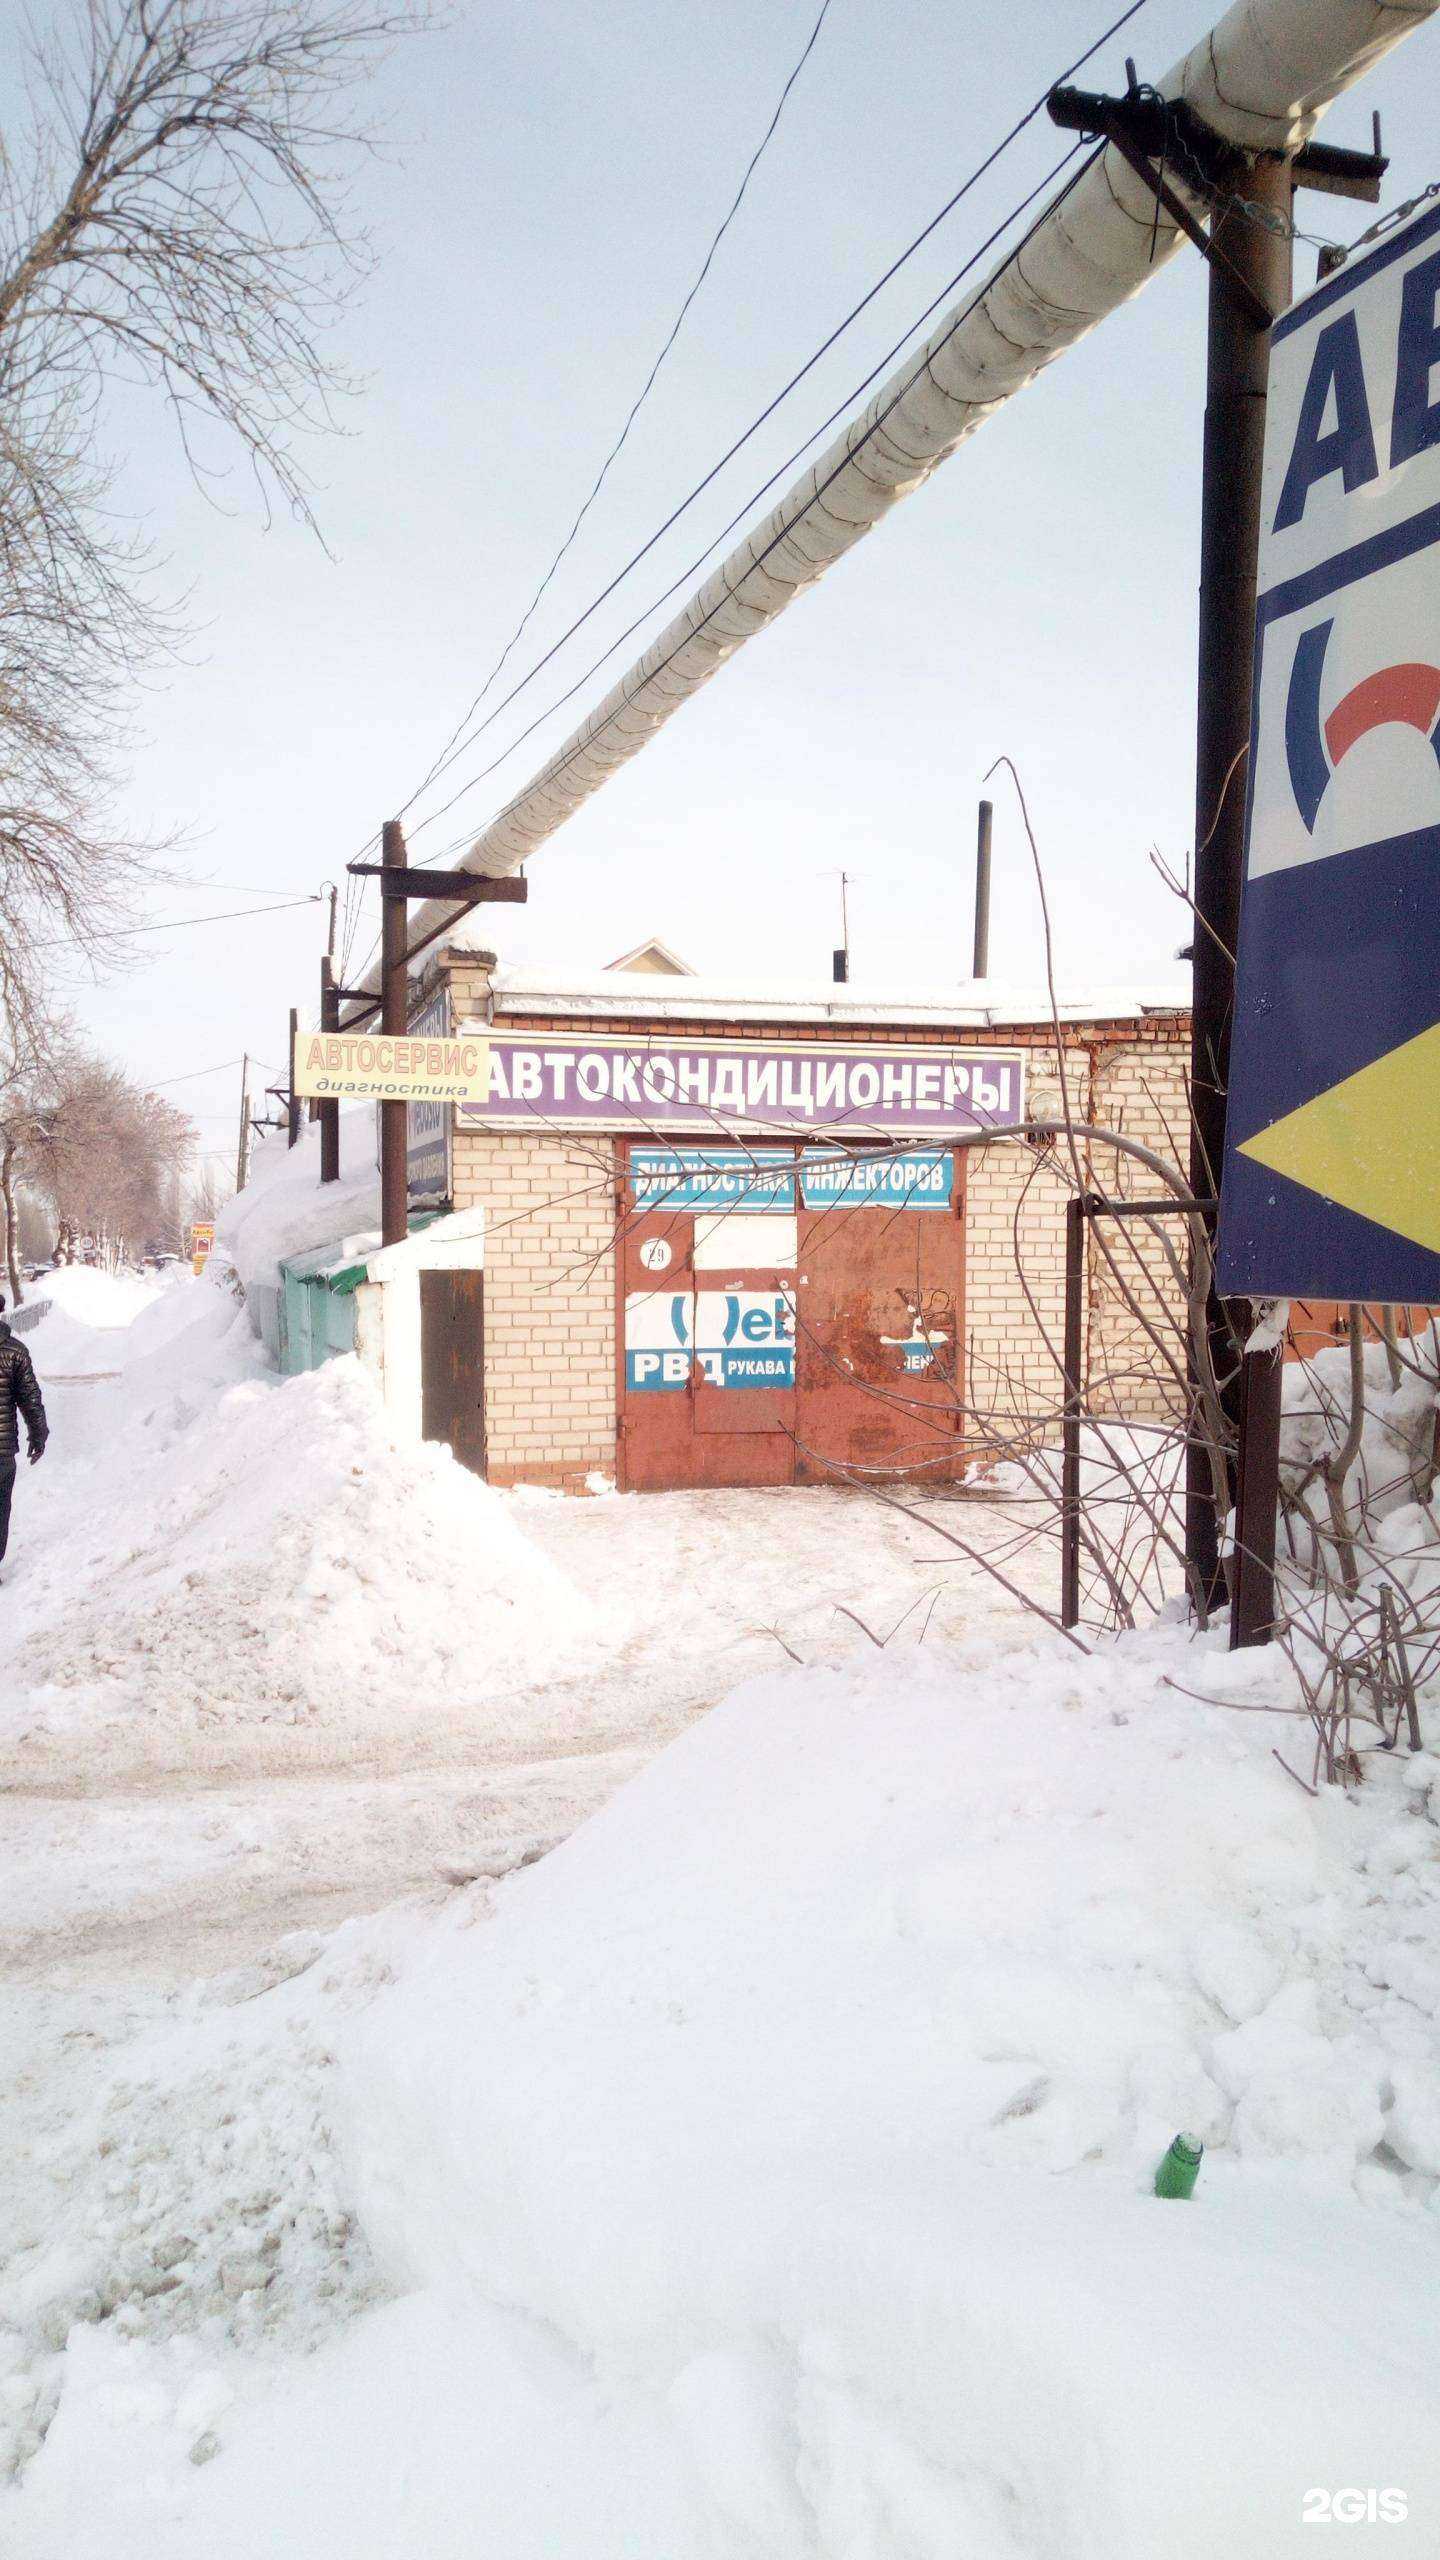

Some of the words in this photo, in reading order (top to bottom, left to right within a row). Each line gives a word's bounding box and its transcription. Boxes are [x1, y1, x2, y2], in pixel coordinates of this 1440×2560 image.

[306, 1038, 478, 1078] АВТОСЕРВИС
[316, 1077, 468, 1096] диагностика
[487, 1050, 1011, 1117] АВТОКОНДИЦИОНЕРЫ
[805, 1160, 944, 1191] ИНЖЕКТОРОВ
[634, 1353, 725, 1386] РВД
[727, 1360, 786, 1376] РУКАВА
